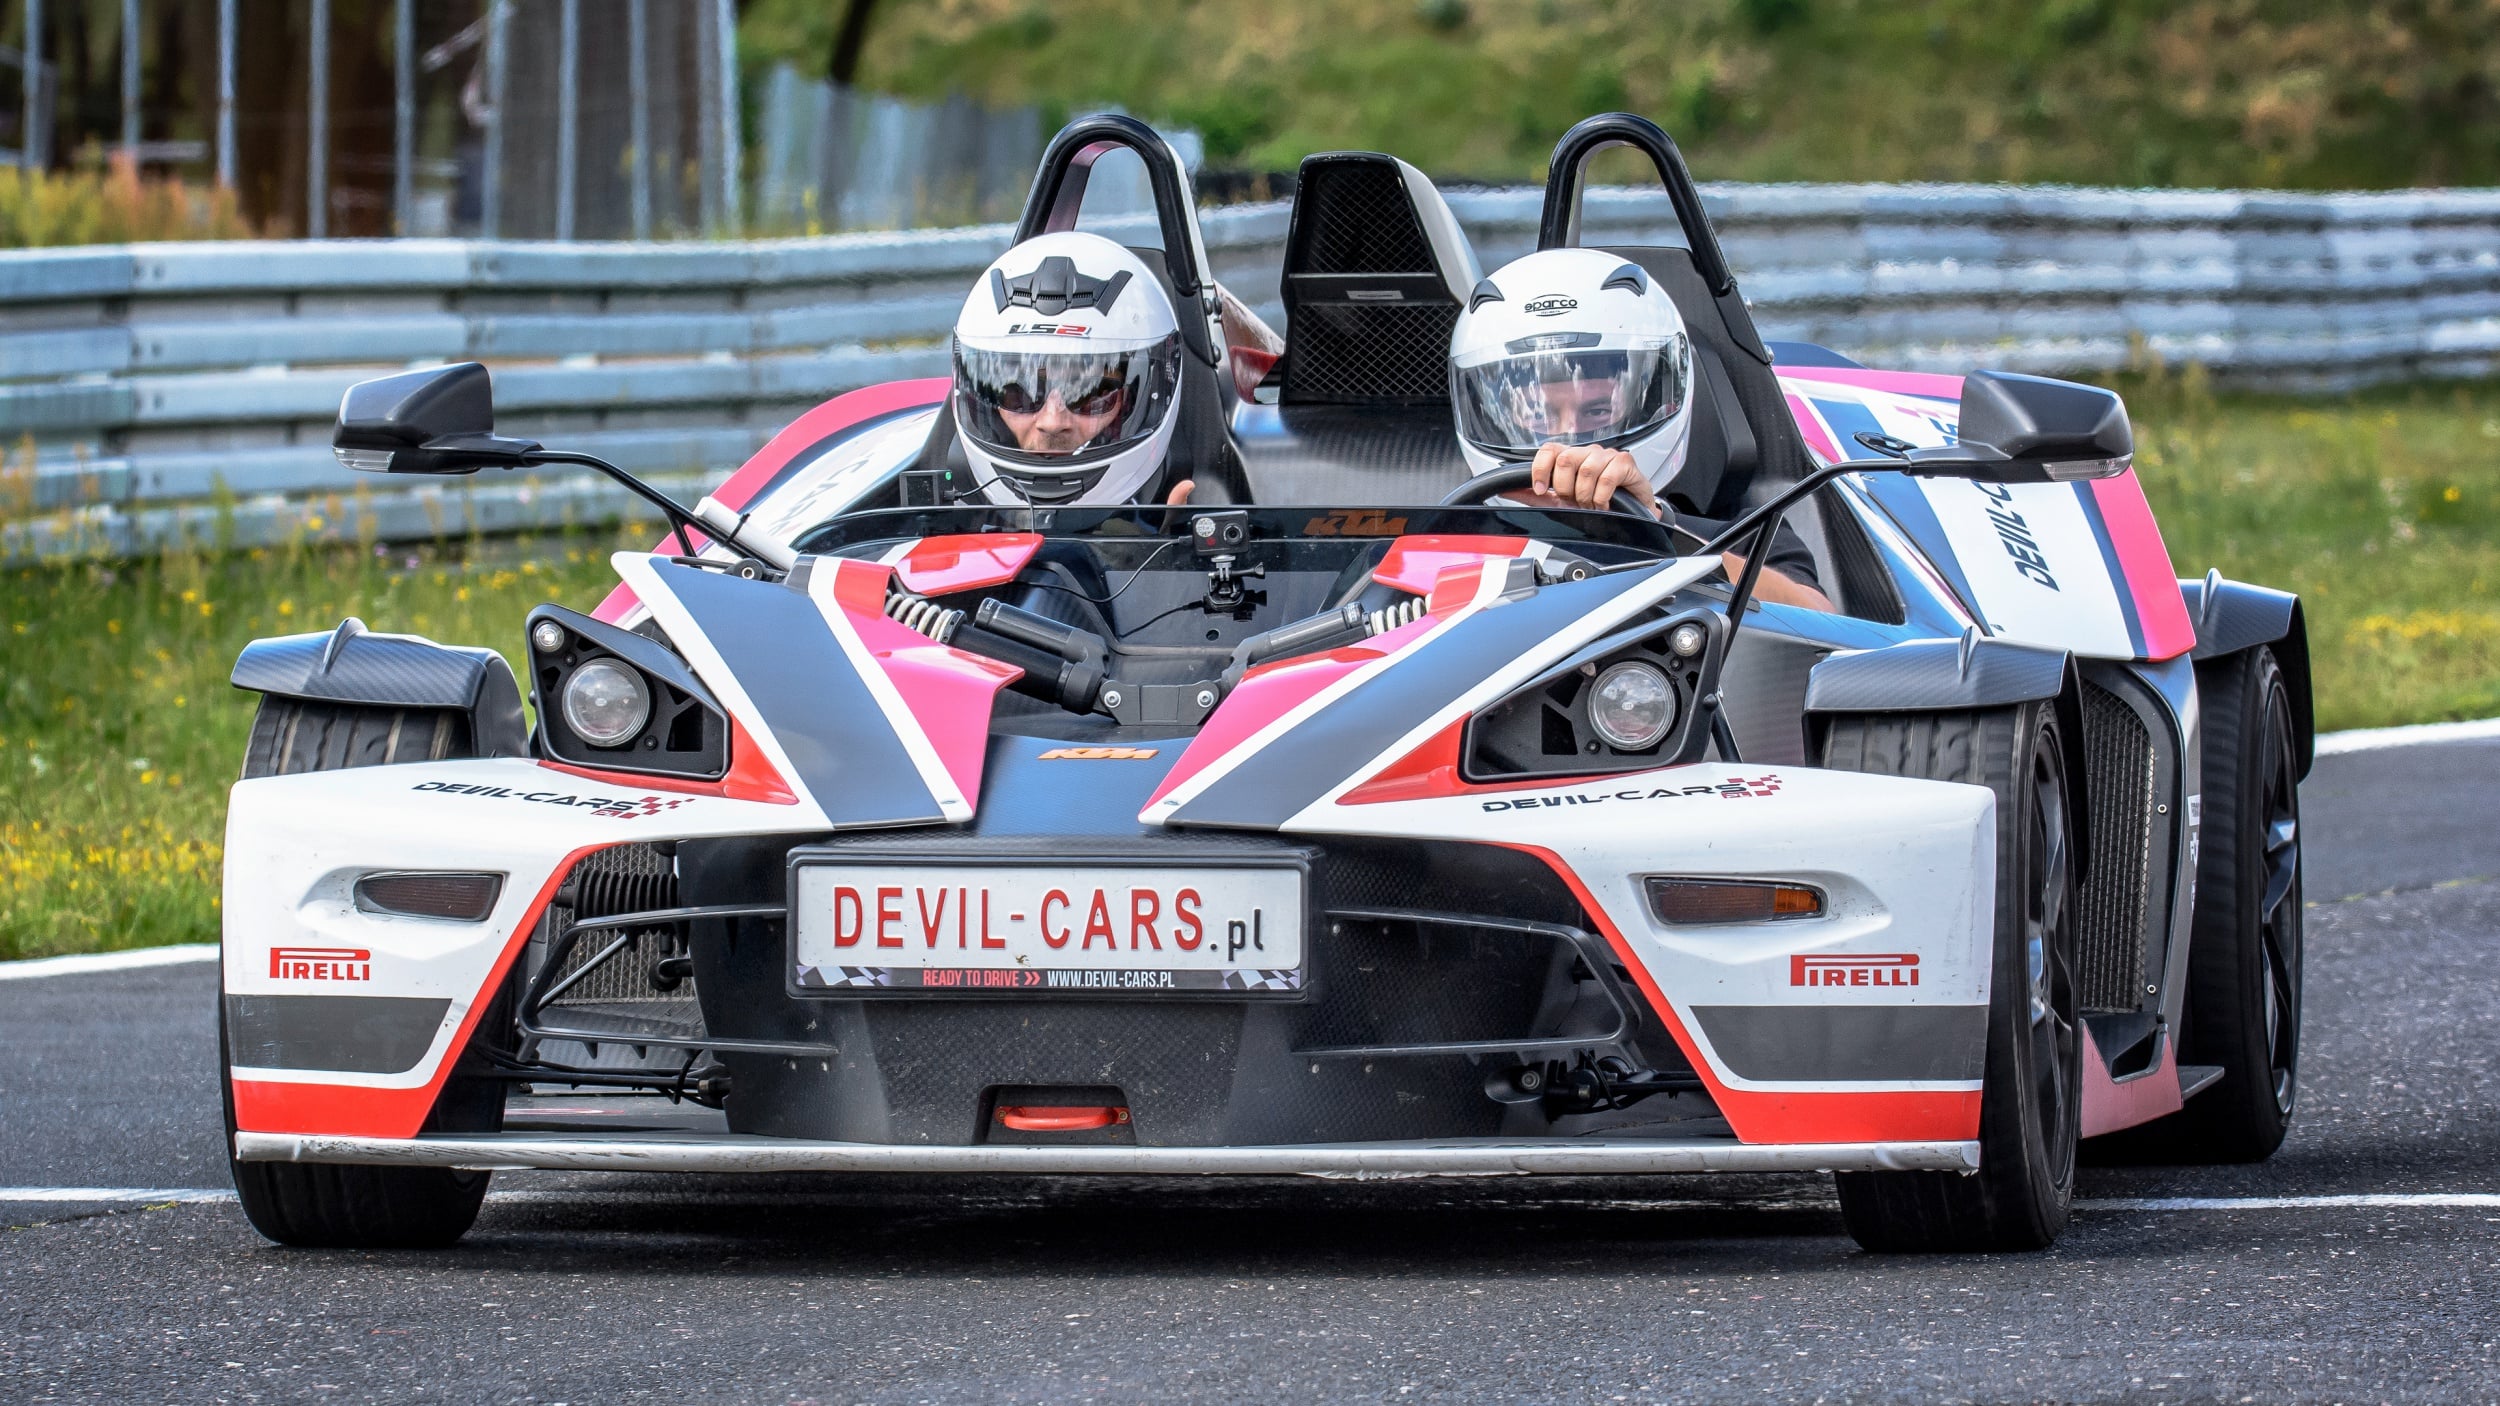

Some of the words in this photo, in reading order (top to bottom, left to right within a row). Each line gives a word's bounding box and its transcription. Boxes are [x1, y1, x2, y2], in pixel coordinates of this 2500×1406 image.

[1008, 323, 1088, 336] LS2
[1303, 509, 1408, 536] KTM
[1037, 747, 1160, 760] KTM
[411, 781, 642, 811] DEVIL-CARS
[1481, 783, 1748, 813] DEVIL-CARS
[833, 886, 1264, 961] DEVIL-CARS.pl
[269, 947, 371, 981] PIRELLI
[923, 970, 961, 986] READY
[966, 970, 981, 986] TO
[984, 970, 1019, 986] DRIVE
[1047, 970, 1175, 988] WWW.DEVIL-CARS.PL
[1790, 953, 1920, 987] PIRELLI
